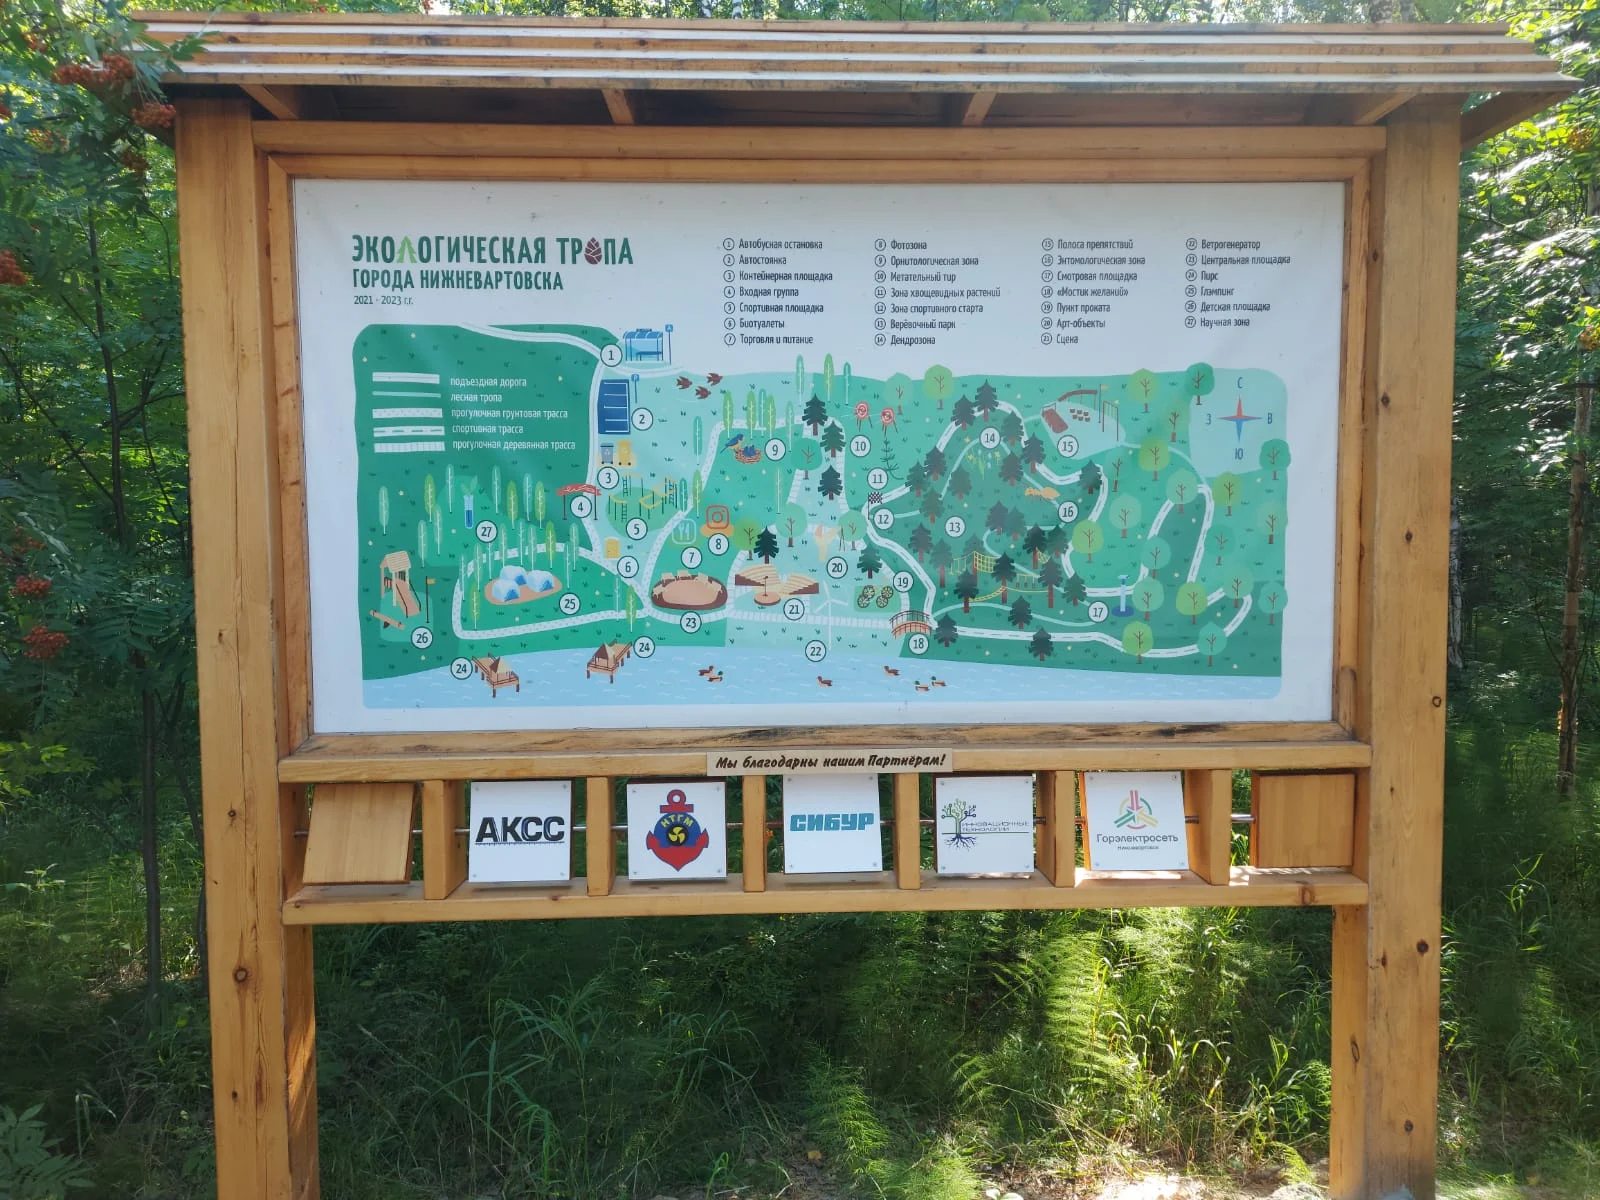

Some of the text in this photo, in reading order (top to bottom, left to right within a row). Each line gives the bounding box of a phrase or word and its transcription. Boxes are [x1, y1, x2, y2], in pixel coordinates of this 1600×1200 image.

[352, 234, 634, 264] ЭКОЛОГИЧЕСКАЯ ТРОПА
[739, 238, 782, 250] Автобусная
[784, 240, 822, 249] остановка
[891, 240, 927, 250] Фотозона
[1058, 239, 1084, 249] Полоса
[1087, 239, 1133, 251] препятствий
[1202, 239, 1260, 251] Ветрогенератор
[739, 254, 786, 264] Автостоянка
[891, 256, 959, 268] Орнитологическая
[1058, 255, 1126, 265] Энтомологическая
[1202, 255, 1249, 267] Центральная
[1252, 256, 1291, 265] площадка
[353, 269, 564, 292] ГОРОДА НИЖНЕВАРТОВСКА
[740, 270, 792, 283] Контейнерная
[794, 272, 832, 282] площадка
[891, 272, 941, 281] Метательный
[943, 274, 956, 284] тир
[1057, 271, 1096, 282] Смотровая
[1099, 272, 1137, 282] площадка
[1201, 270, 1218, 282] Пирс
[740, 286, 771, 298] Входная
[774, 288, 799, 299] группа
[891, 288, 908, 298] Зона
[910, 289, 964, 299] хвощевидных
[967, 287, 1000, 299] растений
[1057, 286, 1088, 296] «Мостик
[1091, 286, 1128, 296] желаний»
[1201, 286, 1234, 296] Глэмпинг
[354, 296, 373, 304] 2021
[381, 296, 402, 305] 2023
[740, 302, 783, 314] Спортивная
[785, 304, 824, 314] площадка
[891, 303, 908, 313] Зона
[910, 305, 956, 316] спортивного
[958, 305, 983, 315] старта
[1057, 302, 1079, 314] Пункт
[1081, 304, 1110, 314] проката
[1200, 302, 1231, 313] Детская
[1233, 303, 1270, 312] площадка
[740, 318, 784, 330] Биотуалеты
[890, 319, 936, 331] Верёвочный
[938, 321, 955, 331] парк
[1057, 318, 1105, 330] Арт-объекты
[1201, 317, 1231, 329] Научная
[740, 334, 774, 346] Торговля
[783, 336, 813, 344] питание
[890, 335, 935, 346] Дендрозона
[1056, 334, 1078, 345] Сцена
[450, 378, 526, 389] подъездная дорога
[1237, 378, 1243, 388] С
[451, 393, 502, 404] лесная тропа
[452, 409, 568, 420] прогулочная грунтовая трасса
[1267, 413, 1272, 424] В
[453, 425, 523, 436] спортивная трасса
[453, 440, 576, 452] прогулочная деревянная трасса
[1235, 448, 1244, 459] Ю
[716, 757, 736, 769] Мы
[742, 756, 818, 769] благодарны
[823, 757, 865, 768] нашим
[660, 814, 694, 828] НТГМ
[790, 813, 874, 832] СИБУР
[475, 816, 565, 842] АКСС
[1096, 834, 1178, 844] Горэлектросеть
